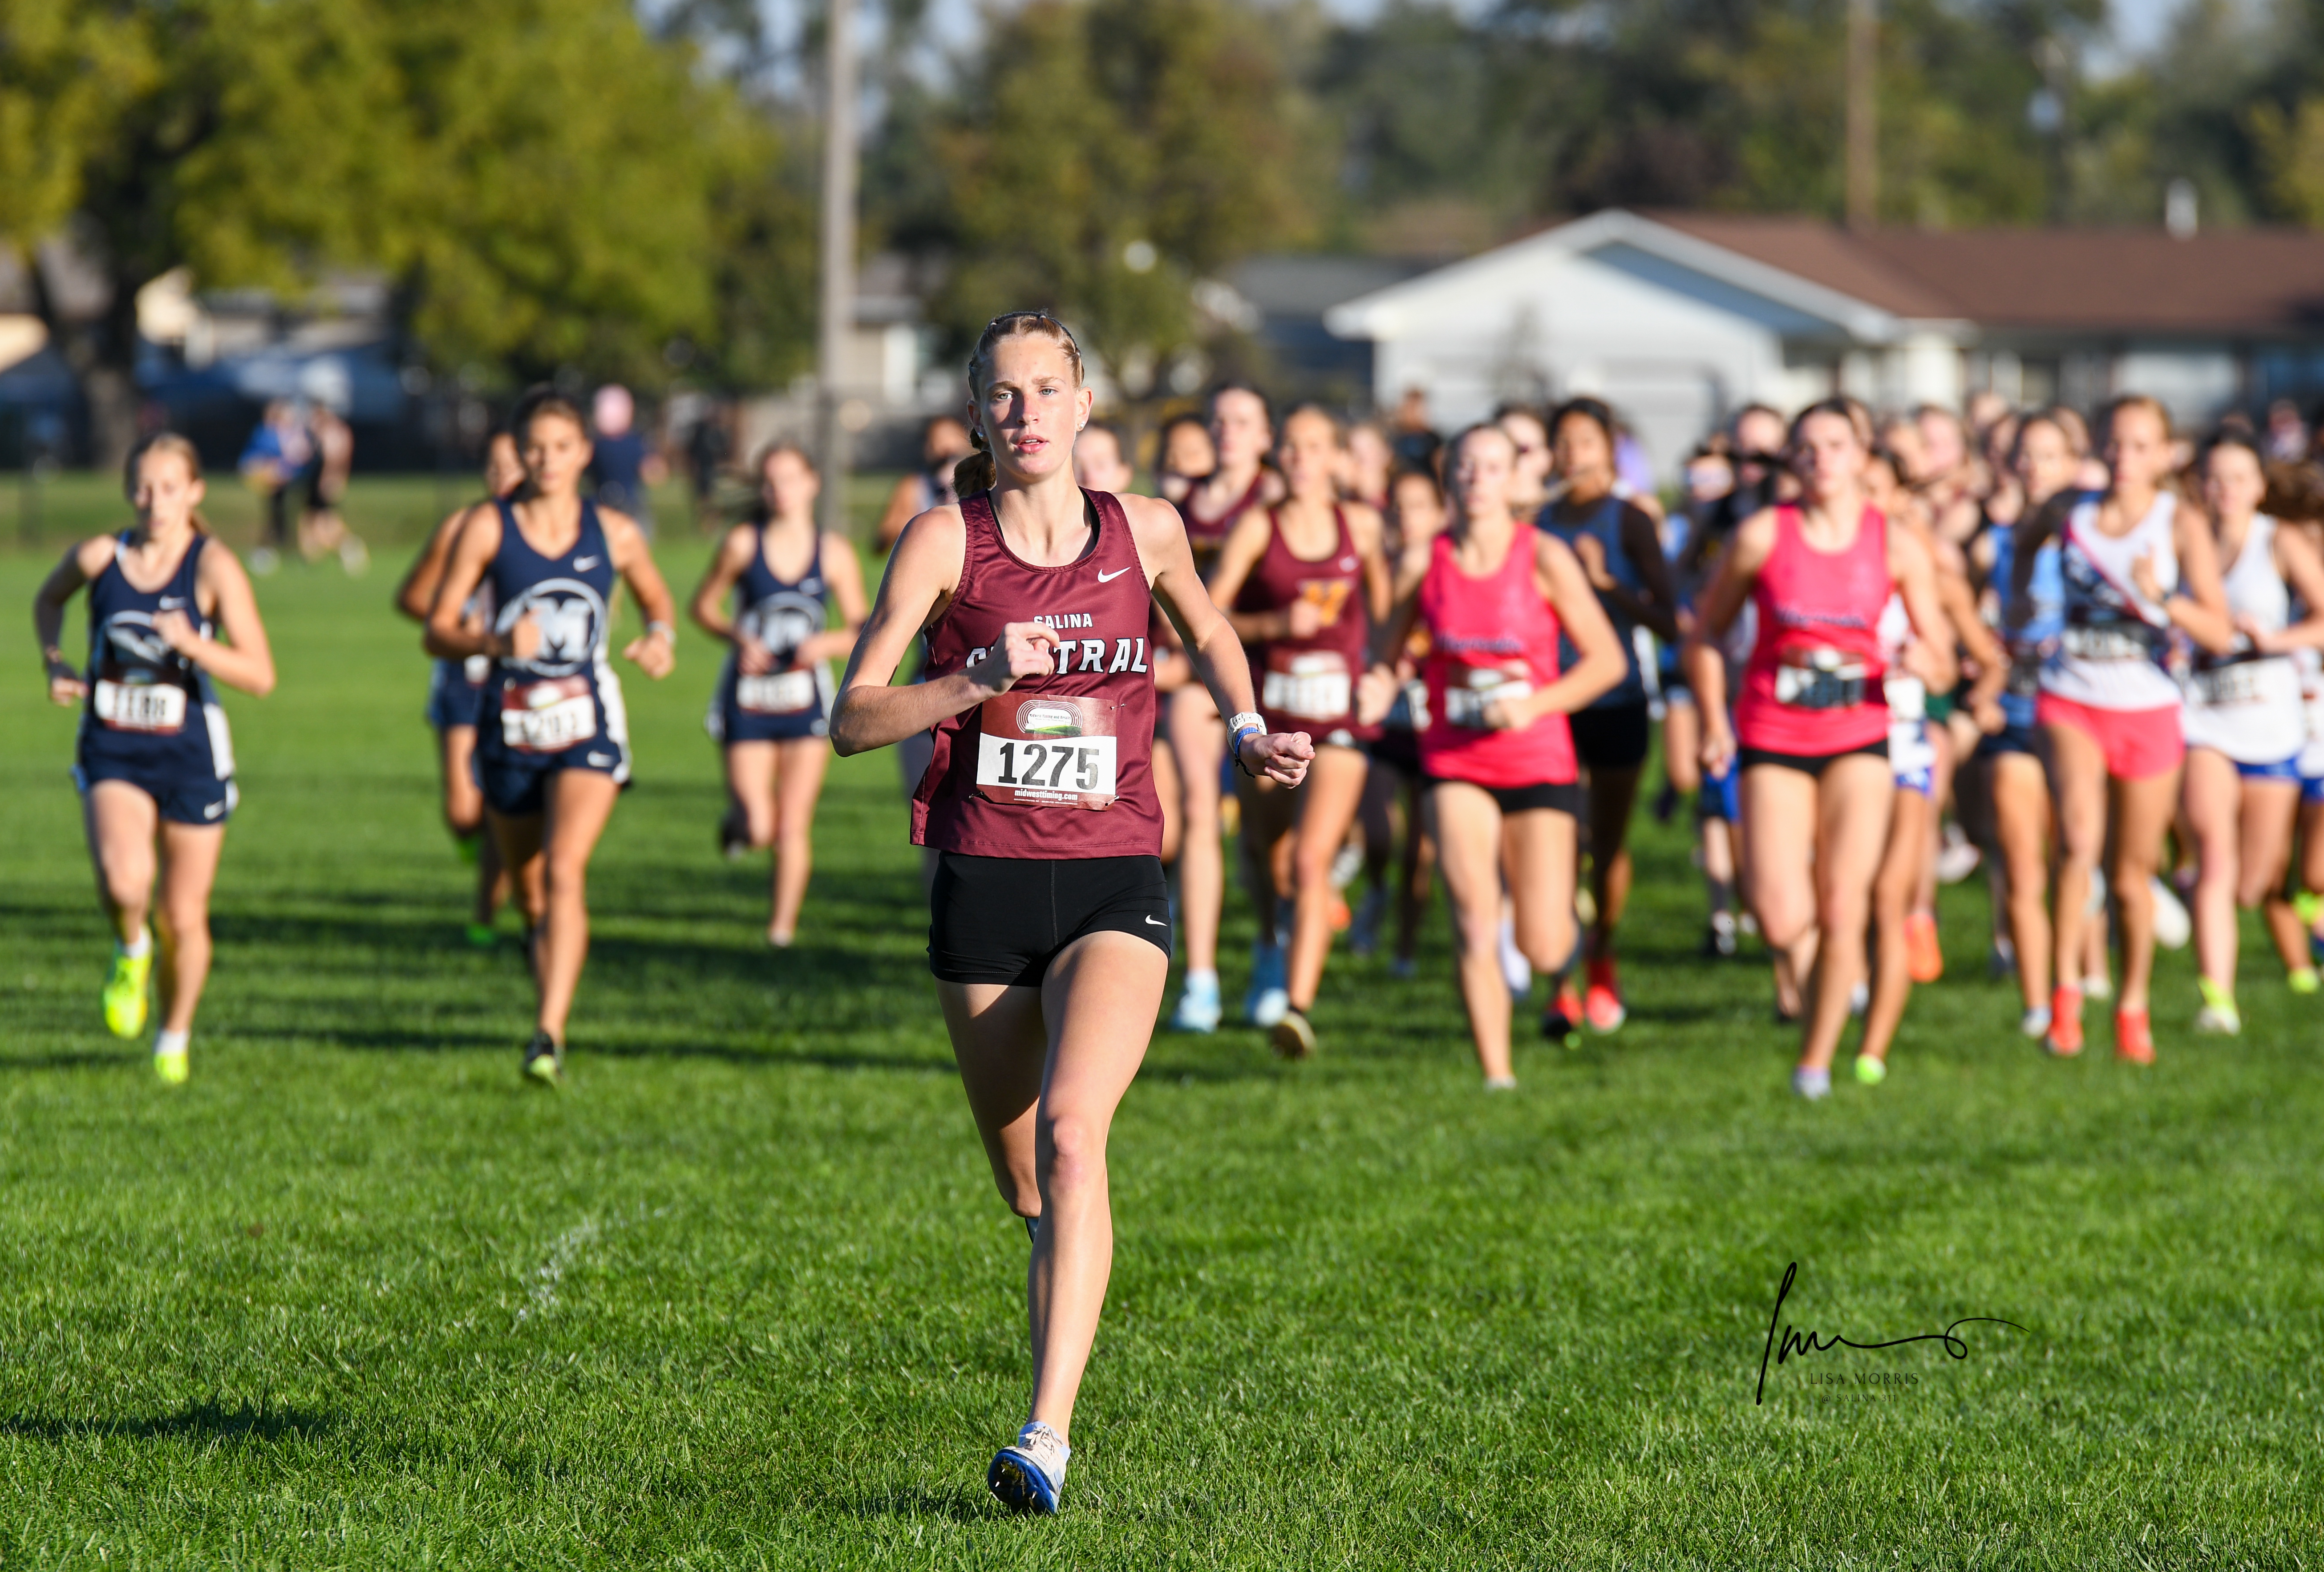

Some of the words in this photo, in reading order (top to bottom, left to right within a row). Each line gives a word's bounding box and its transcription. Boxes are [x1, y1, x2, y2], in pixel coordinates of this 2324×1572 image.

[1034, 613, 1093, 629] SALINA
[966, 637, 1148, 675] CTRAL
[998, 742, 1098, 790] 1275
[1014, 789, 1078, 801] midwesttiming.com
